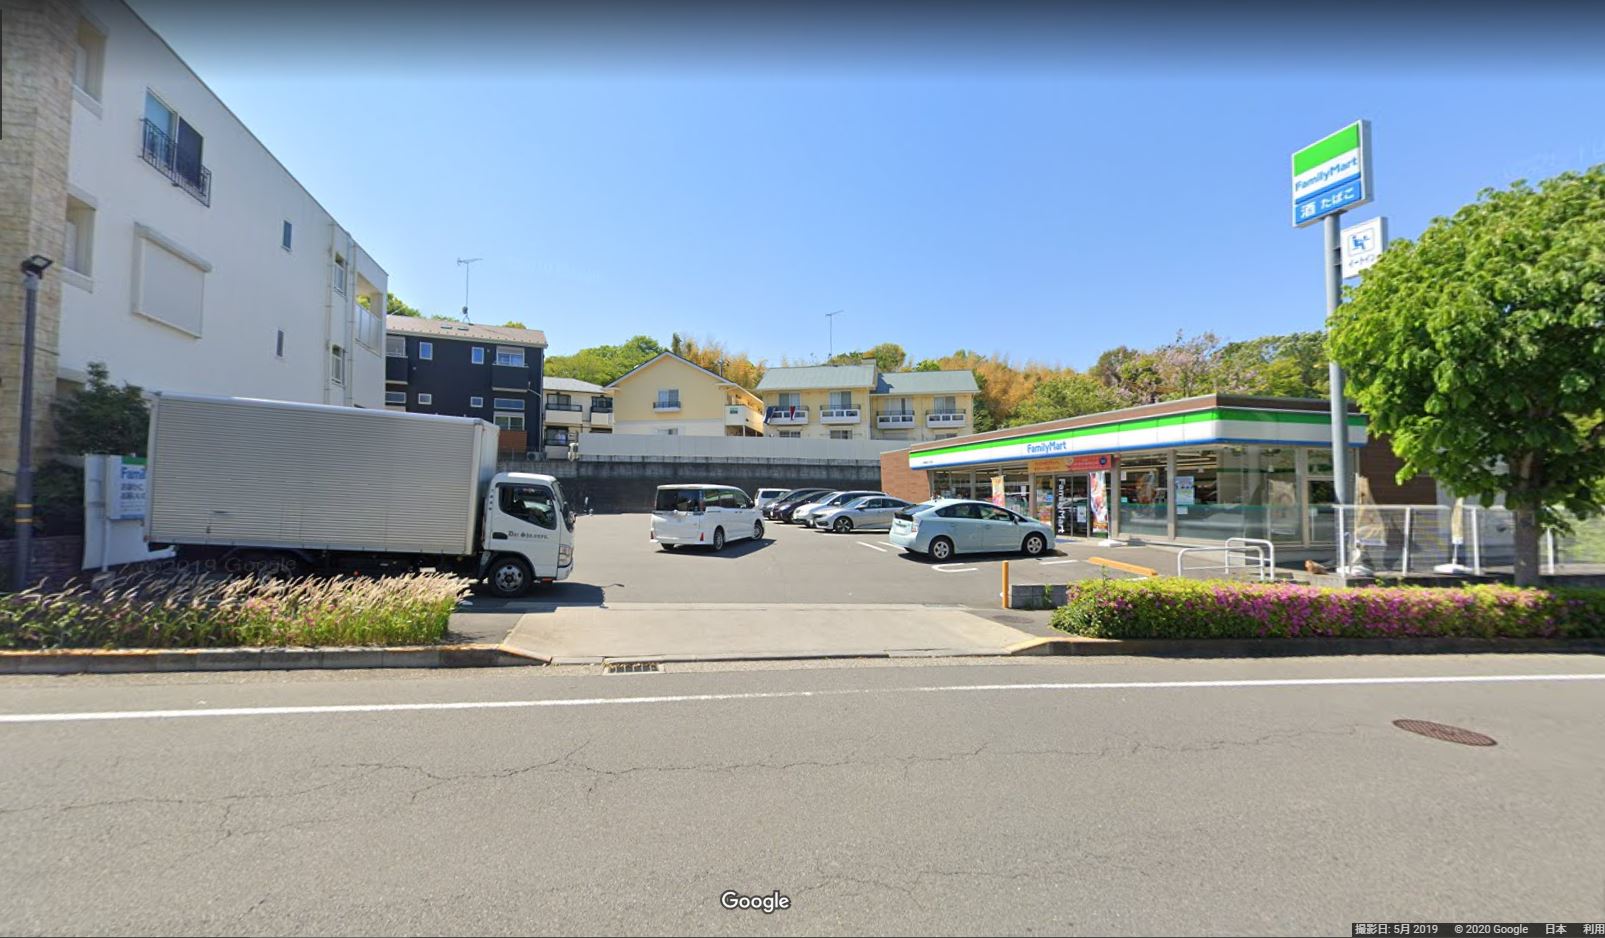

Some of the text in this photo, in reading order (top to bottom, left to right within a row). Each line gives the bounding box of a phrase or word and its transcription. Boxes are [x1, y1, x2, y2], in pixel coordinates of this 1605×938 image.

[1295, 157, 1358, 191] FamilyMart
[1300, 187, 1354, 218] 酒 たばこ
[1027, 441, 1067, 454] FamilyMart
[1057, 478, 1067, 533] FamilyMart
